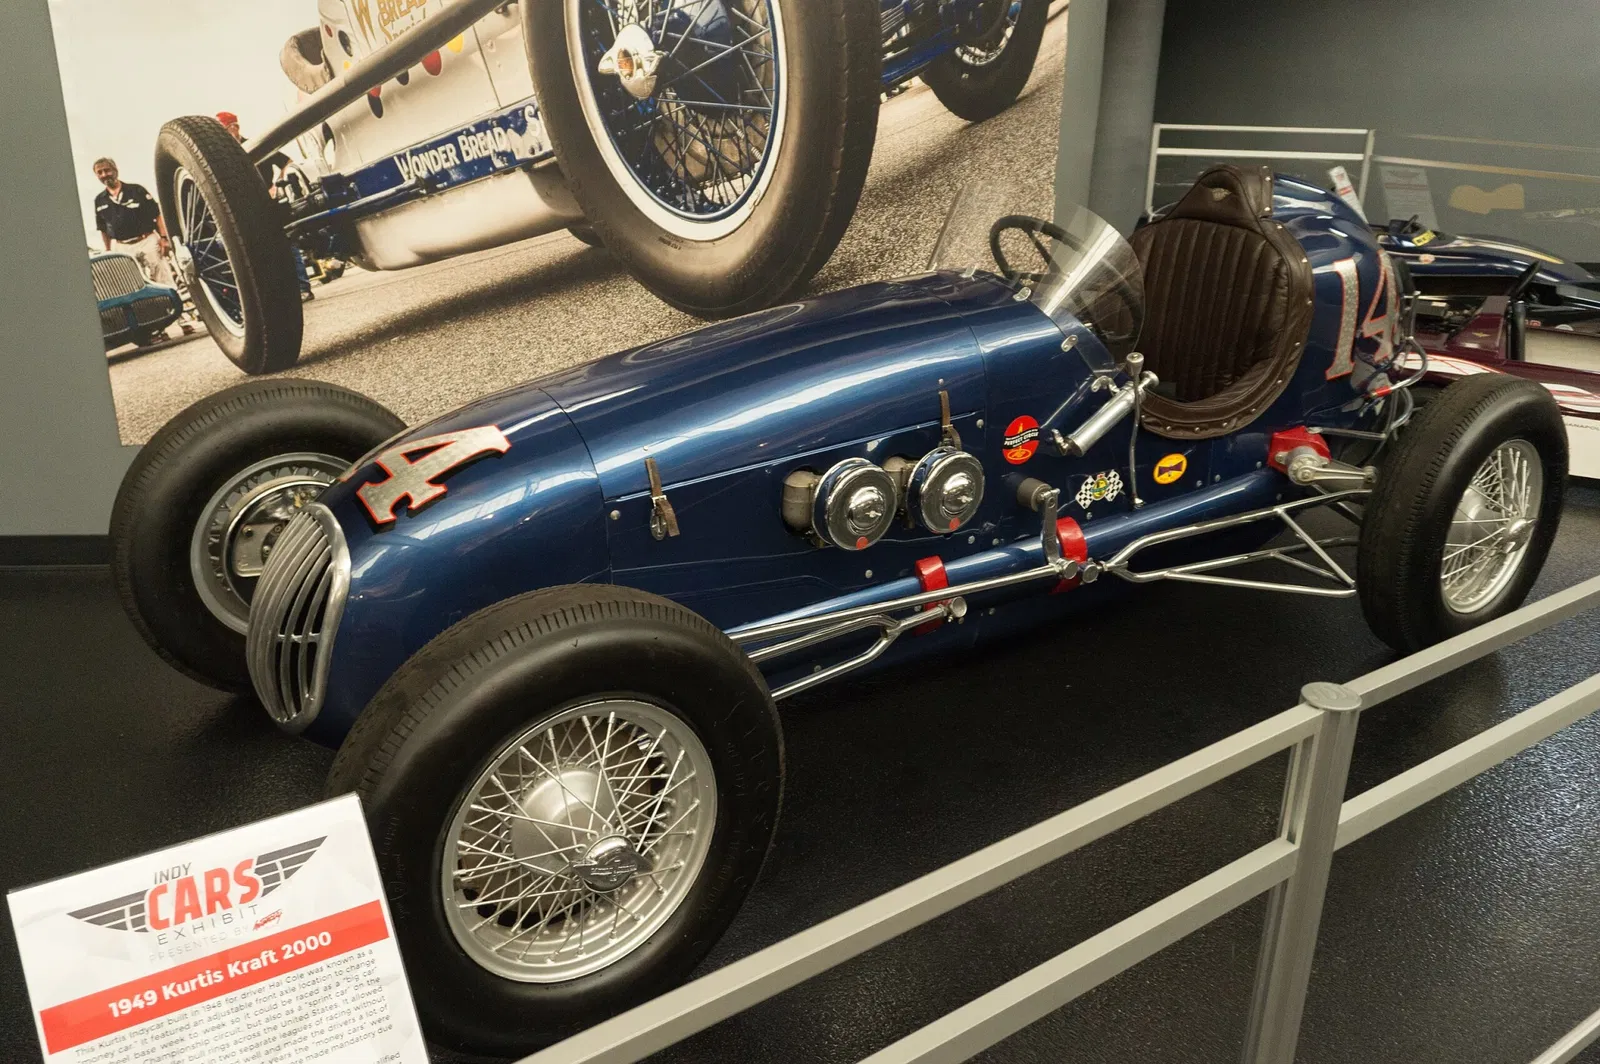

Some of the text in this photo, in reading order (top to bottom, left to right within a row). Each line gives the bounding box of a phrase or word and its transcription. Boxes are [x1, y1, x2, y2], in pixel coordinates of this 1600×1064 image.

[394, 143, 460, 181] WONDER
[457, 127, 508, 163] BREAD
[1325, 249, 1399, 381] 14
[355, 424, 512, 526] 4
[148, 858, 260, 931] CARS
[154, 862, 192, 885] INDY
[149, 931, 228, 964] PRESENTED
[157, 904, 258, 946] EXHIBIT
[75, 1046, 96, 1057] This
[98, 1034, 126, 1049] Kurtis
[129, 1021, 165, 1039] Indycar
[167, 1012, 189, 1025] built
[191, 1008, 200, 1017] in
[225, 996, 238, 1005] for
[240, 985, 266, 1000] driver
[268, 979, 283, 990] Hal
[286, 972, 305, 984] Cole
[307, 966, 324, 976] was
[327, 955, 355, 969] known
[357, 951, 366, 959] as
[108, 931, 332, 1018] 1949 Kurtis Kraft 2000
[151, 1022, 191, 1042] featured
[193, 1018, 205, 1028] an
[207, 1001, 254, 1023] adjustable
[255, 992, 278, 1005] front
[279, 985, 297, 997] axle
[298, 973, 333, 989] location
[334, 969, 344, 977] to
[345, 958, 376, 973] change
[133, 1046, 157, 1060] base
[160, 1035, 186, 1051] week
[189, 1031, 200, 1040] to
[203, 1022, 228, 1035] week
[231, 1016, 241, 1025] so
[244, 1011, 252, 1020] it
[254, 1001, 279, 1017] could
[281, 996, 293, 1006] be
[296, 987, 320, 1001] raced
[323, 984, 333, 992] as
[143, 1038, 211, 1064] Championship
[246, 1018, 263, 1030] but
[265, 1011, 282, 1024] also
[285, 1008, 295, 1016] as
[353, 983, 364, 991] on
[366, 976, 381, 987] the
[188, 1050, 206, 1062] bull
[208, 1042, 231, 1055] rings
[233, 1031, 261, 1046] across
[263, 1024, 278, 1034] the
[280, 1011, 310, 1028] United
[351, 985, 384, 1003] allowed
[219, 1050, 237, 1062] two
[239, 1034, 277, 1055] separate
[279, 1022, 312, 1039] leagues
[315, 1016, 323, 1027] of
[325, 1008, 352, 1022] racing
[353, 995, 386, 1012] without
[243, 1049, 262, 1063] well
[264, 1044, 281, 1056] and
[283, 1035, 308, 1049] made
[310, 1028, 325, 1038] the
[327, 1016, 356, 1032] drivers
[365, 1008, 377, 1018] lot
[379, 1003, 388, 1013] of
[268, 1051, 291, 1064] years
[294, 1045, 309, 1056] the
[369, 1014, 391, 1027] were
[305, 1047, 329, 1061] made
[331, 1031, 376, 1053] mandatory
[377, 1022, 393, 1034] due
[376, 1051, 401, 1064] alified
